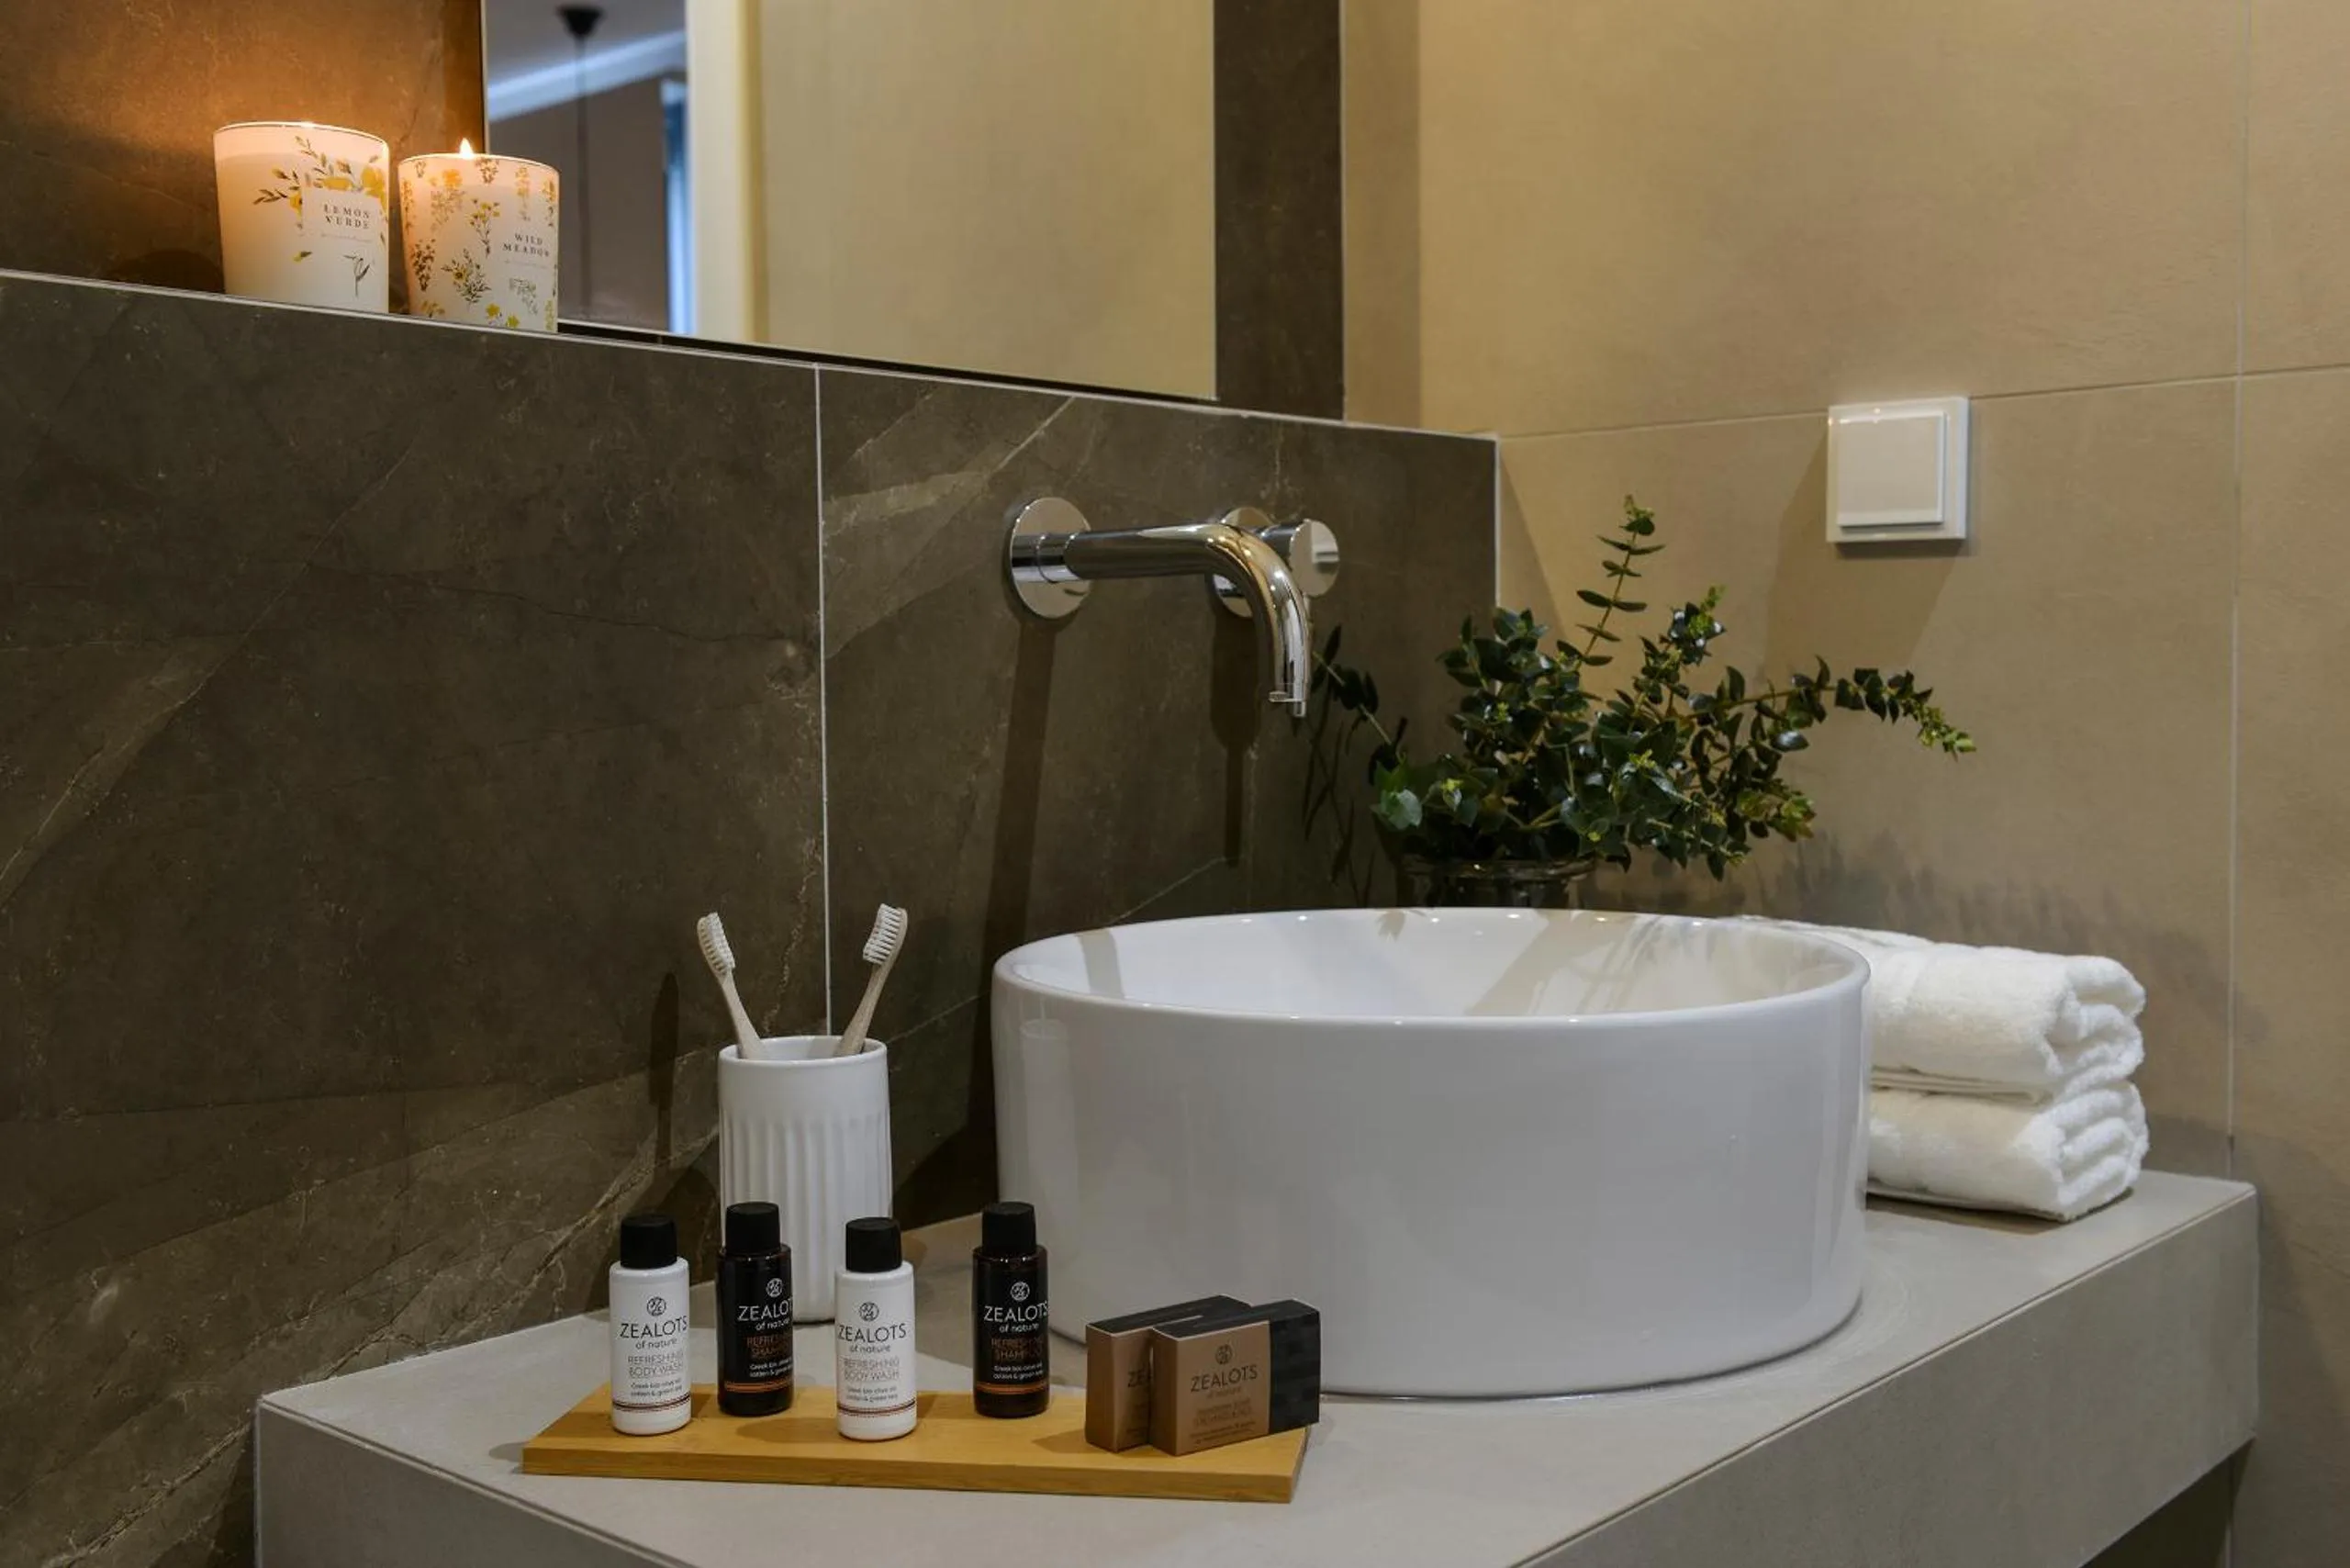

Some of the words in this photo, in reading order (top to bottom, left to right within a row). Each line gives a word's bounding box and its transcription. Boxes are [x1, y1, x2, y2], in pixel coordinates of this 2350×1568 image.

[515, 232, 543, 245] WILD
[983, 1300, 1050, 1322] ZEALOTS
[620, 1316, 688, 1339] ZEALOTS
[755, 1321, 766, 1330] of
[838, 1323, 907, 1343] ZEALOTS
[999, 1324, 1009, 1334] of
[635, 1339, 644, 1350] of
[648, 1338, 677, 1349] nature
[1190, 1364, 1259, 1393] ZEALOTS
